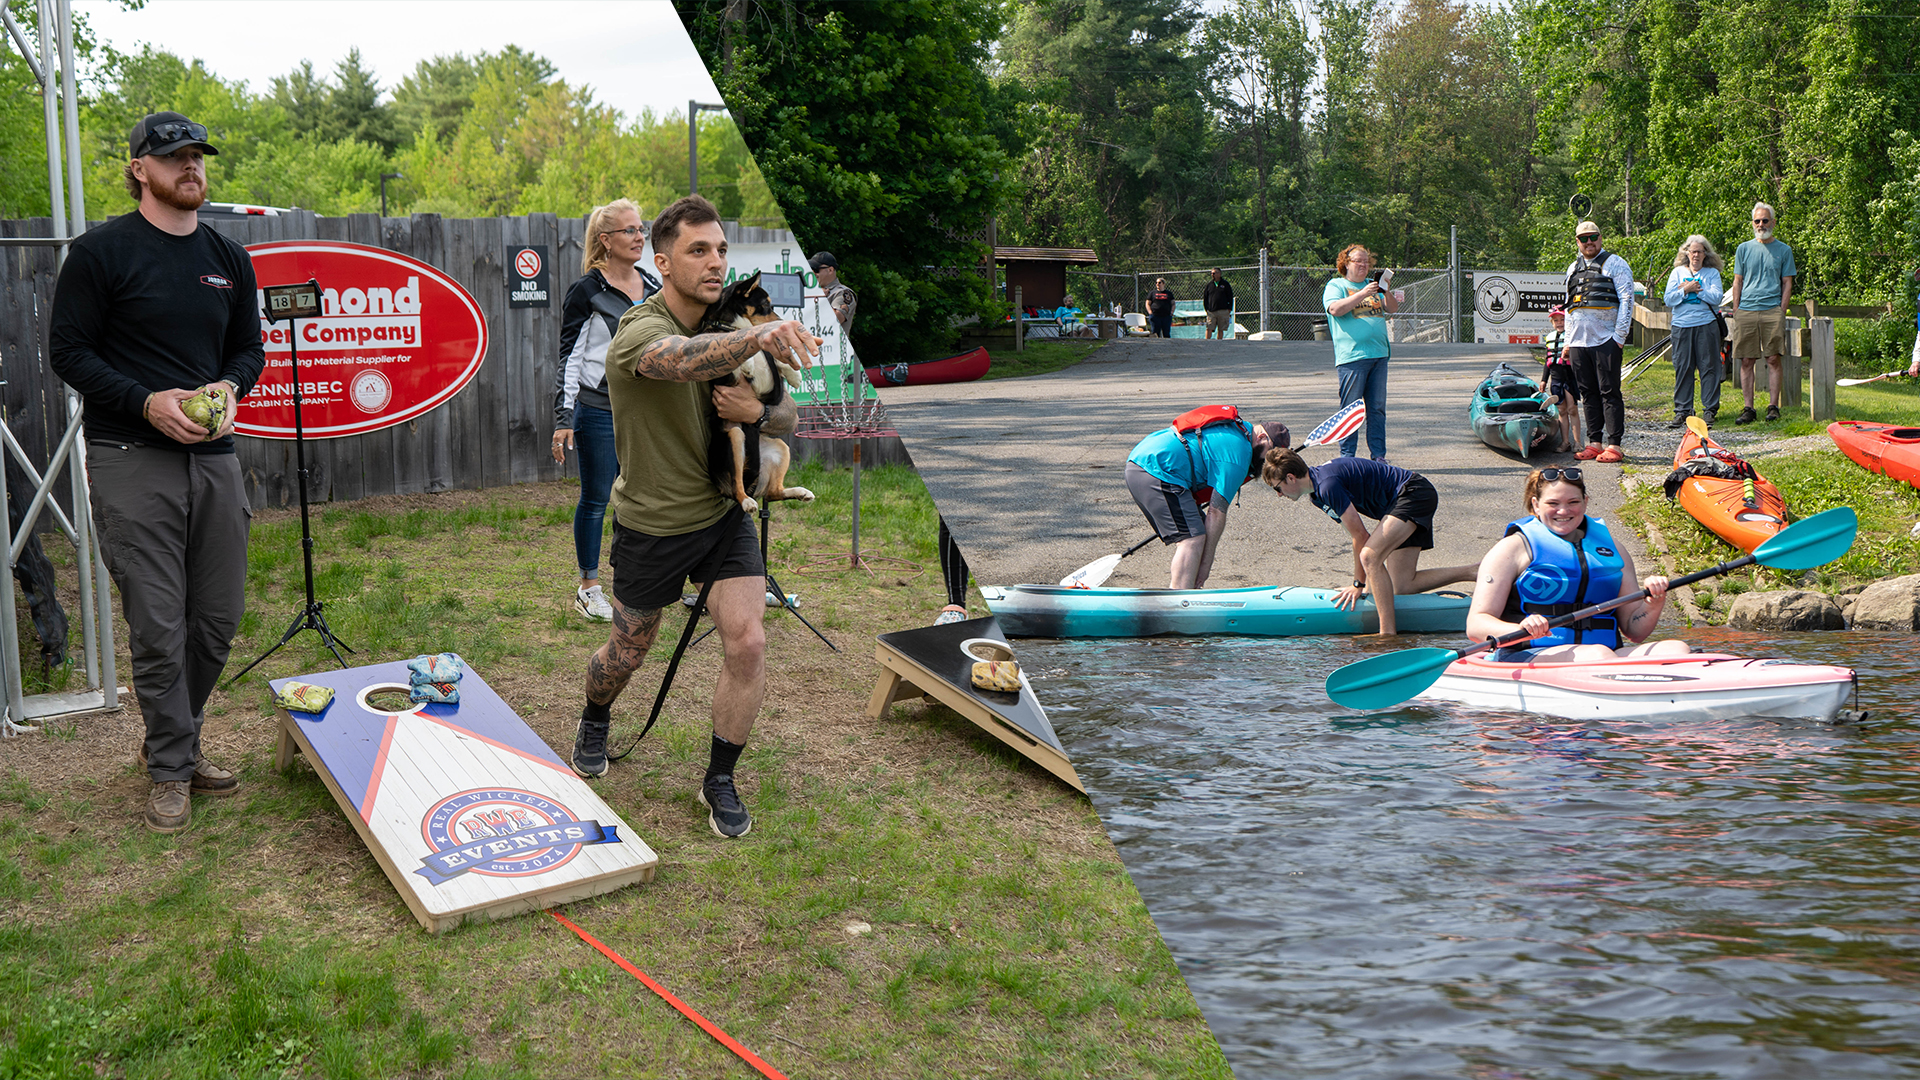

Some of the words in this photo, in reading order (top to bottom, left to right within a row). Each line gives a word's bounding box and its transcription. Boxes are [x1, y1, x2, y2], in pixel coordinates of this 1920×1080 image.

[521, 281, 537, 291] NO
[788, 285, 795, 296] 9
[302, 295, 309, 305] 7
[512, 290, 547, 301] SMOKING
[1520, 292, 1565, 300] Communit
[274, 296, 289, 308] 18
[1527, 301, 1556, 309] Rowin
[302, 323, 416, 346] Company
[314, 356, 355, 366] Material
[355, 354, 396, 366] Supplier
[397, 354, 412, 363] for
[245, 380, 344, 397] ENNEBEC
[249, 399, 281, 408] CABIN
[432, 801, 462, 828] REAL
[467, 792, 549, 809] WICKED
[459, 808, 537, 839] RWE
[439, 826, 586, 869] EVENTS
[491, 863, 515, 871] est.
[520, 849, 564, 870] 2024
